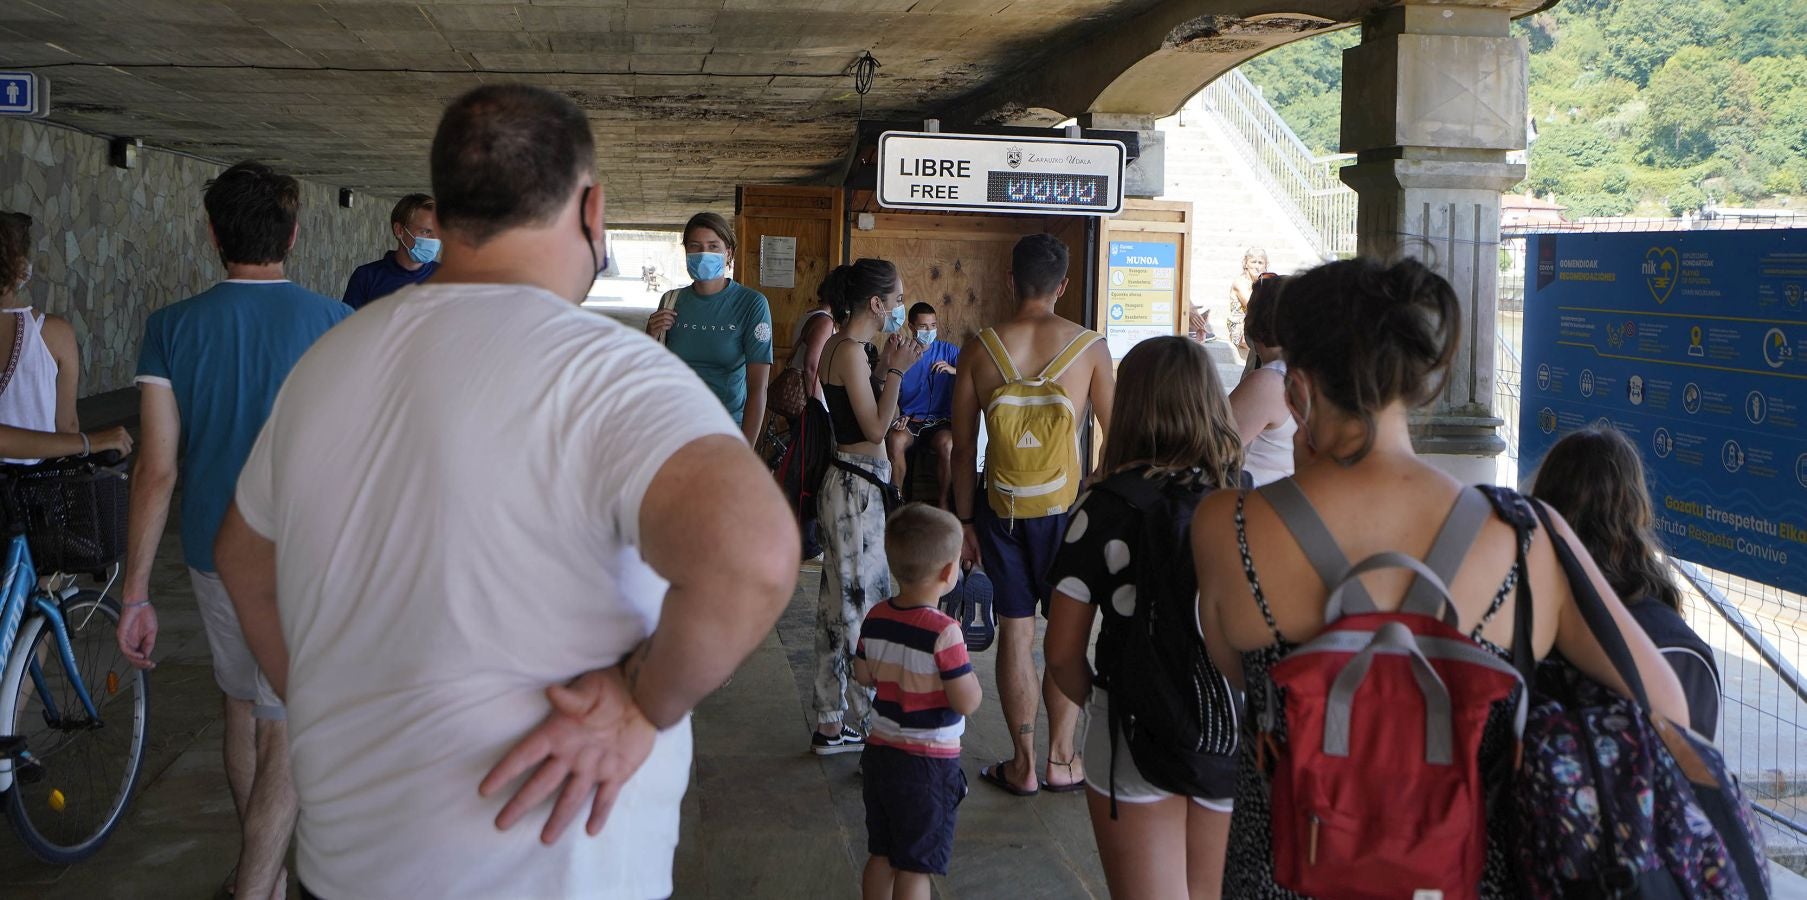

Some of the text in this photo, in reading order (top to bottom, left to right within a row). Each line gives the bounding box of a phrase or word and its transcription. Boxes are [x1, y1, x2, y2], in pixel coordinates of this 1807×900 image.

[900, 158, 971, 178] LIBRE
[910, 184, 959, 200] FREE
[1126, 256, 1159, 265] MUNOA
[1559, 259, 1599, 269] GOMENDIOAK
[1641, 261, 1657, 275] nik
[1665, 496, 1704, 517] Gozatu
[1706, 505, 1777, 536] Errespetatu
[1651, 513, 1788, 565] isfruta Respeta Convive
